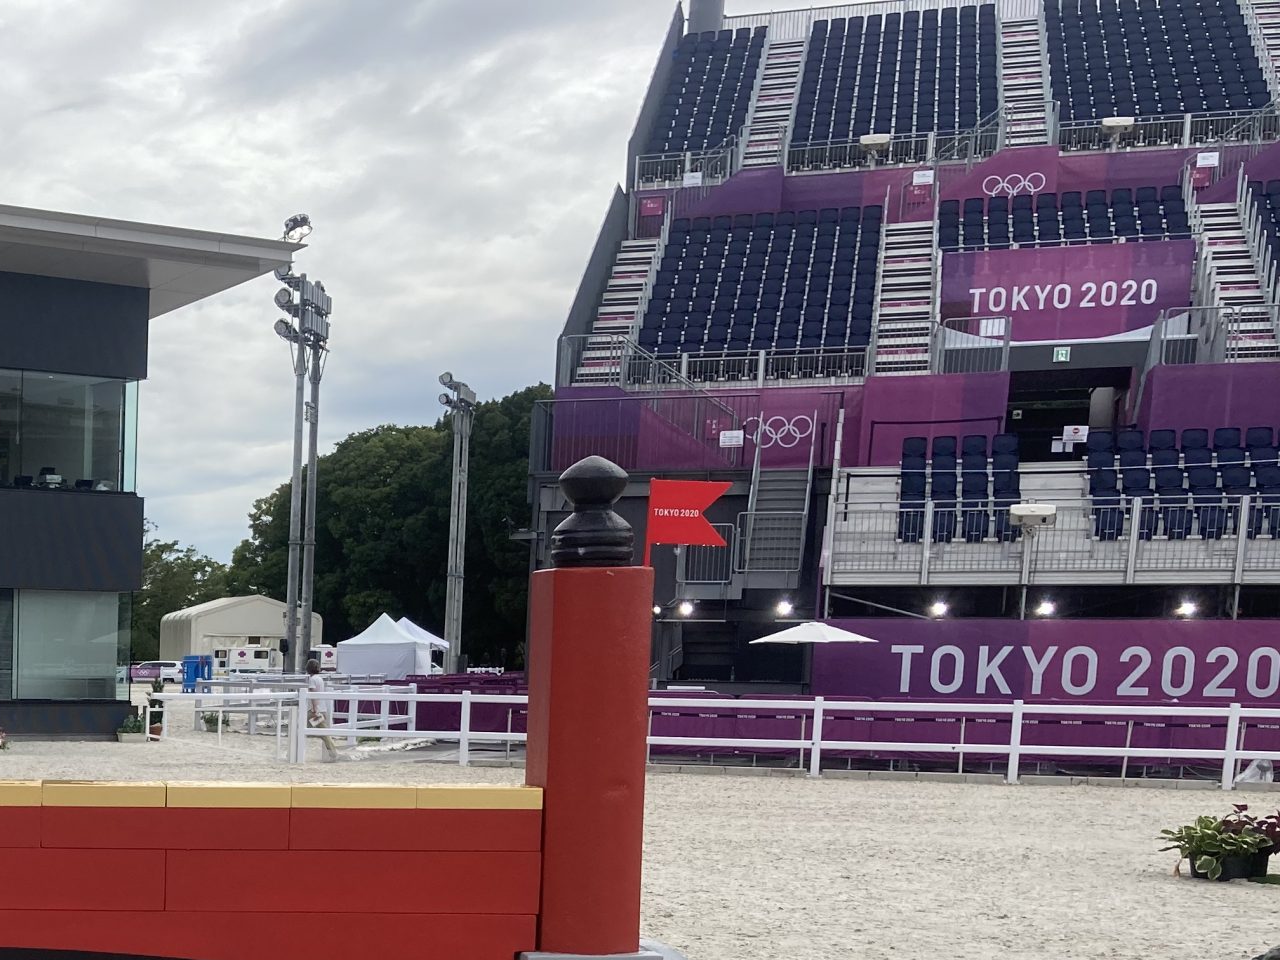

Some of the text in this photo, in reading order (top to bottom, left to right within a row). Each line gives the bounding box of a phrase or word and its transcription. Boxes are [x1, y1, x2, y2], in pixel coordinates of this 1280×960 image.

[969, 279, 1158, 313] TOKYO 2020
[654, 508, 700, 518] TOKYO 2020
[890, 644, 1280, 698] TOKYO 2020
